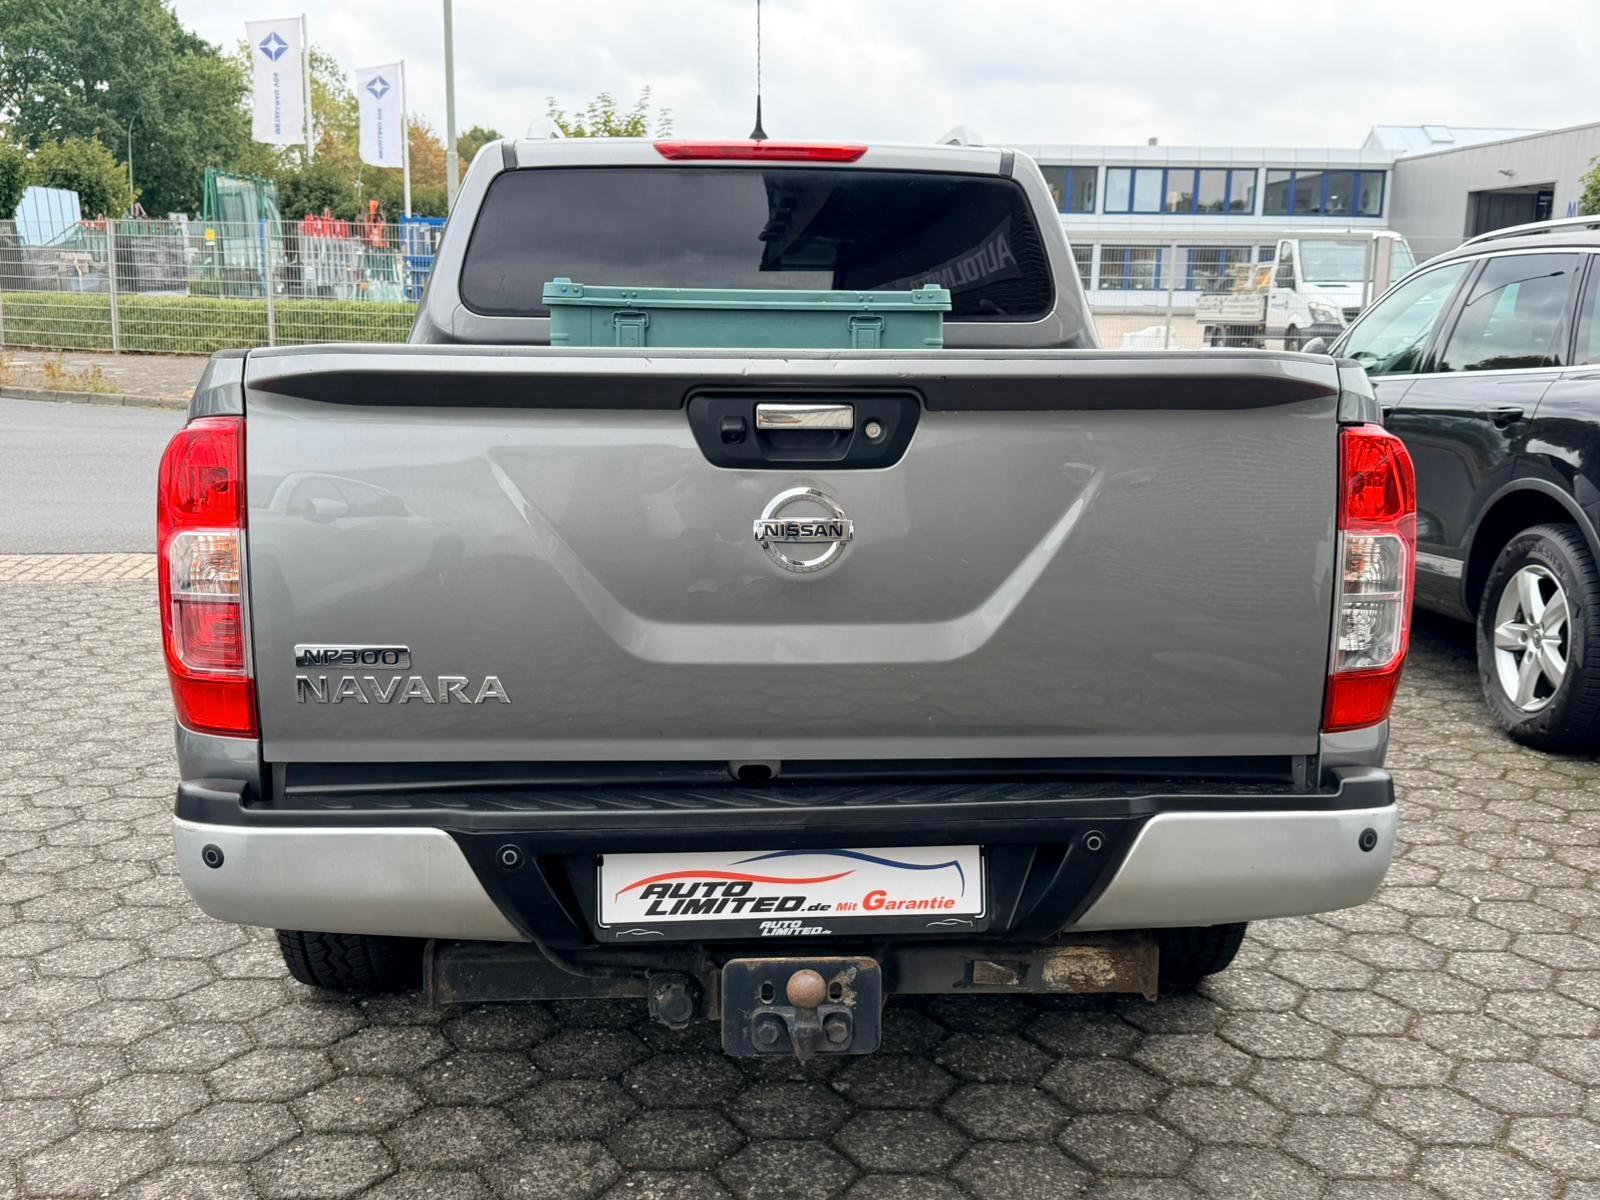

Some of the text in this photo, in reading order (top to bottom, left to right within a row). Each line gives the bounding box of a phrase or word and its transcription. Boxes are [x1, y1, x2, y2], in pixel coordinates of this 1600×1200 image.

[764, 525, 843, 537] NISSAN
[303, 649, 400, 666] NP300
[295, 675, 512, 704] NAVARA
[639, 881, 754, 900] AUTO
[644, 889, 956, 916] LIMITED.de Mit Garantie
[759, 920, 803, 929] AUTO
